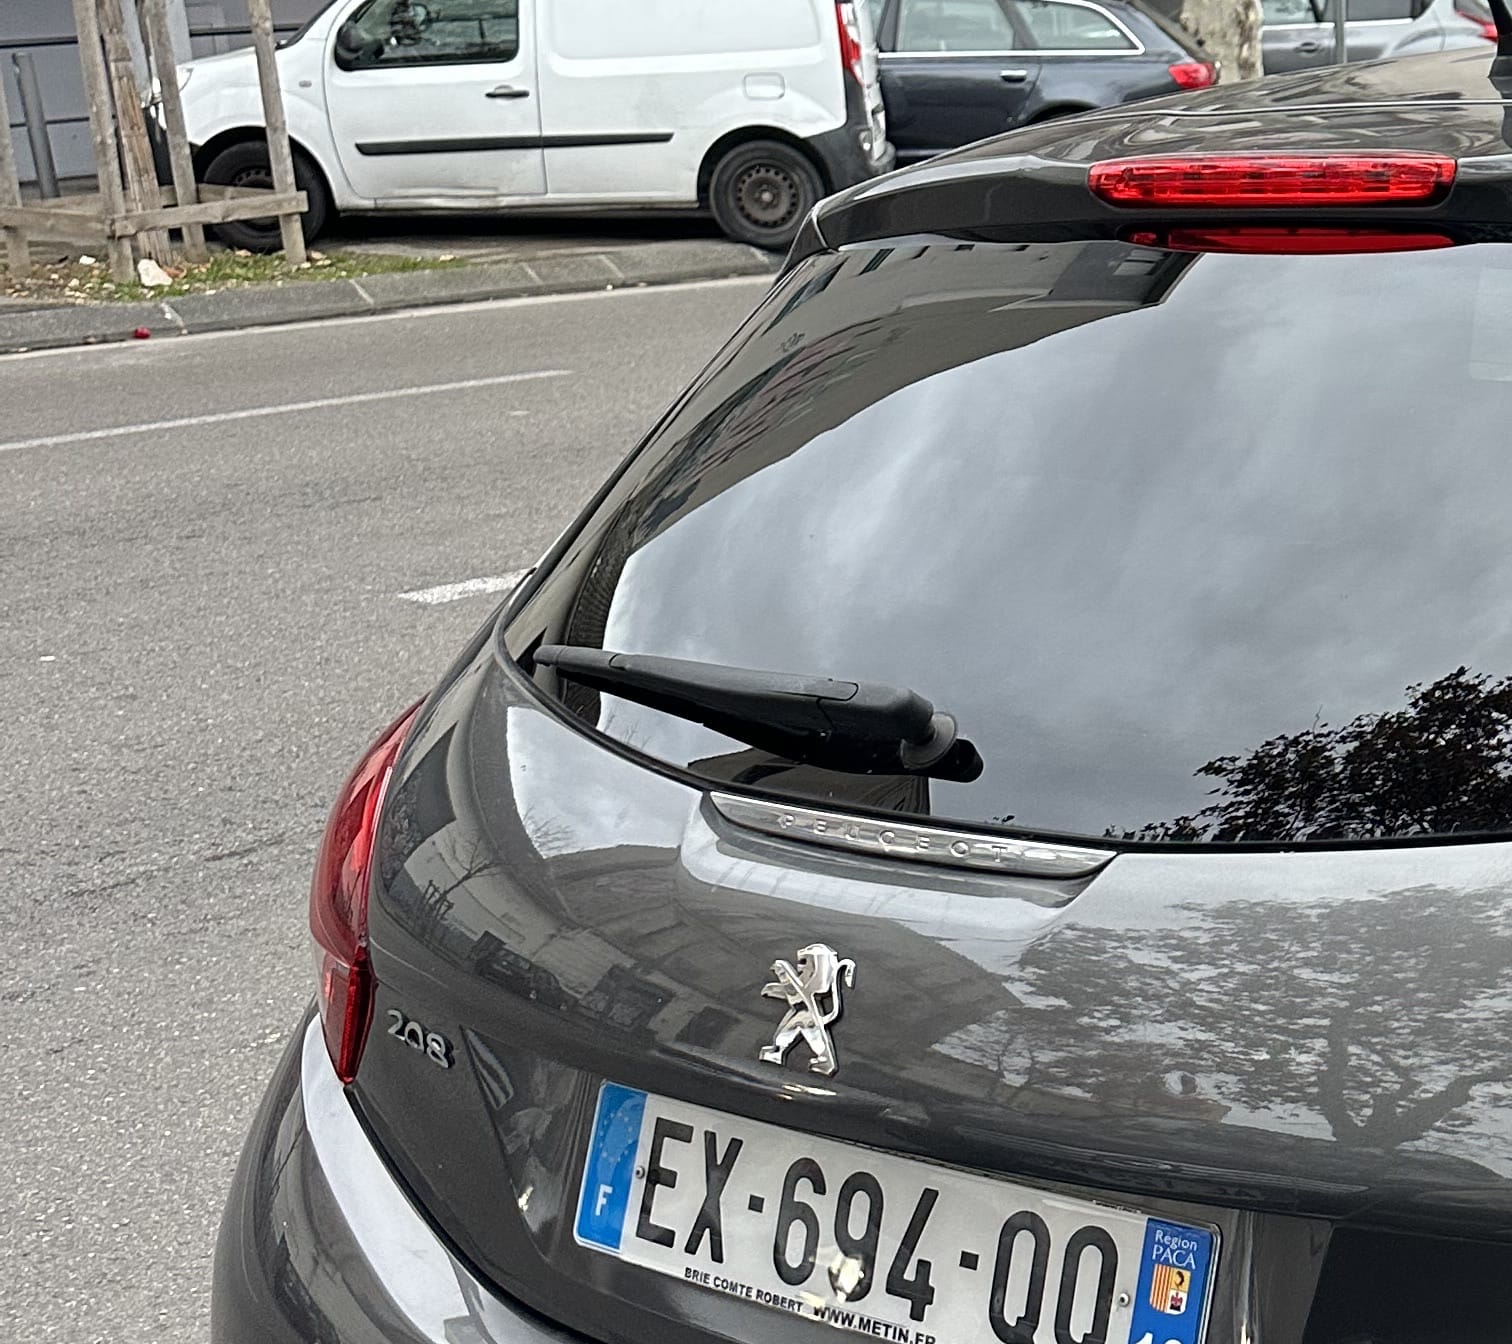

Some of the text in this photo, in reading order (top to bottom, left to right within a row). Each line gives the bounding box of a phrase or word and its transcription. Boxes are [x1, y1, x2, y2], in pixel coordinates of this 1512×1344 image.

[777, 813, 1008, 863] PEUGEOT
[387, 1008, 452, 1069] 208
[594, 1184, 614, 1216] F
[1151, 1244, 1197, 1270] PACA
[684, 1267, 710, 1285] BRIE
[713, 1276, 753, 1297] COMTE
[755, 1289, 804, 1313] ROBERT
